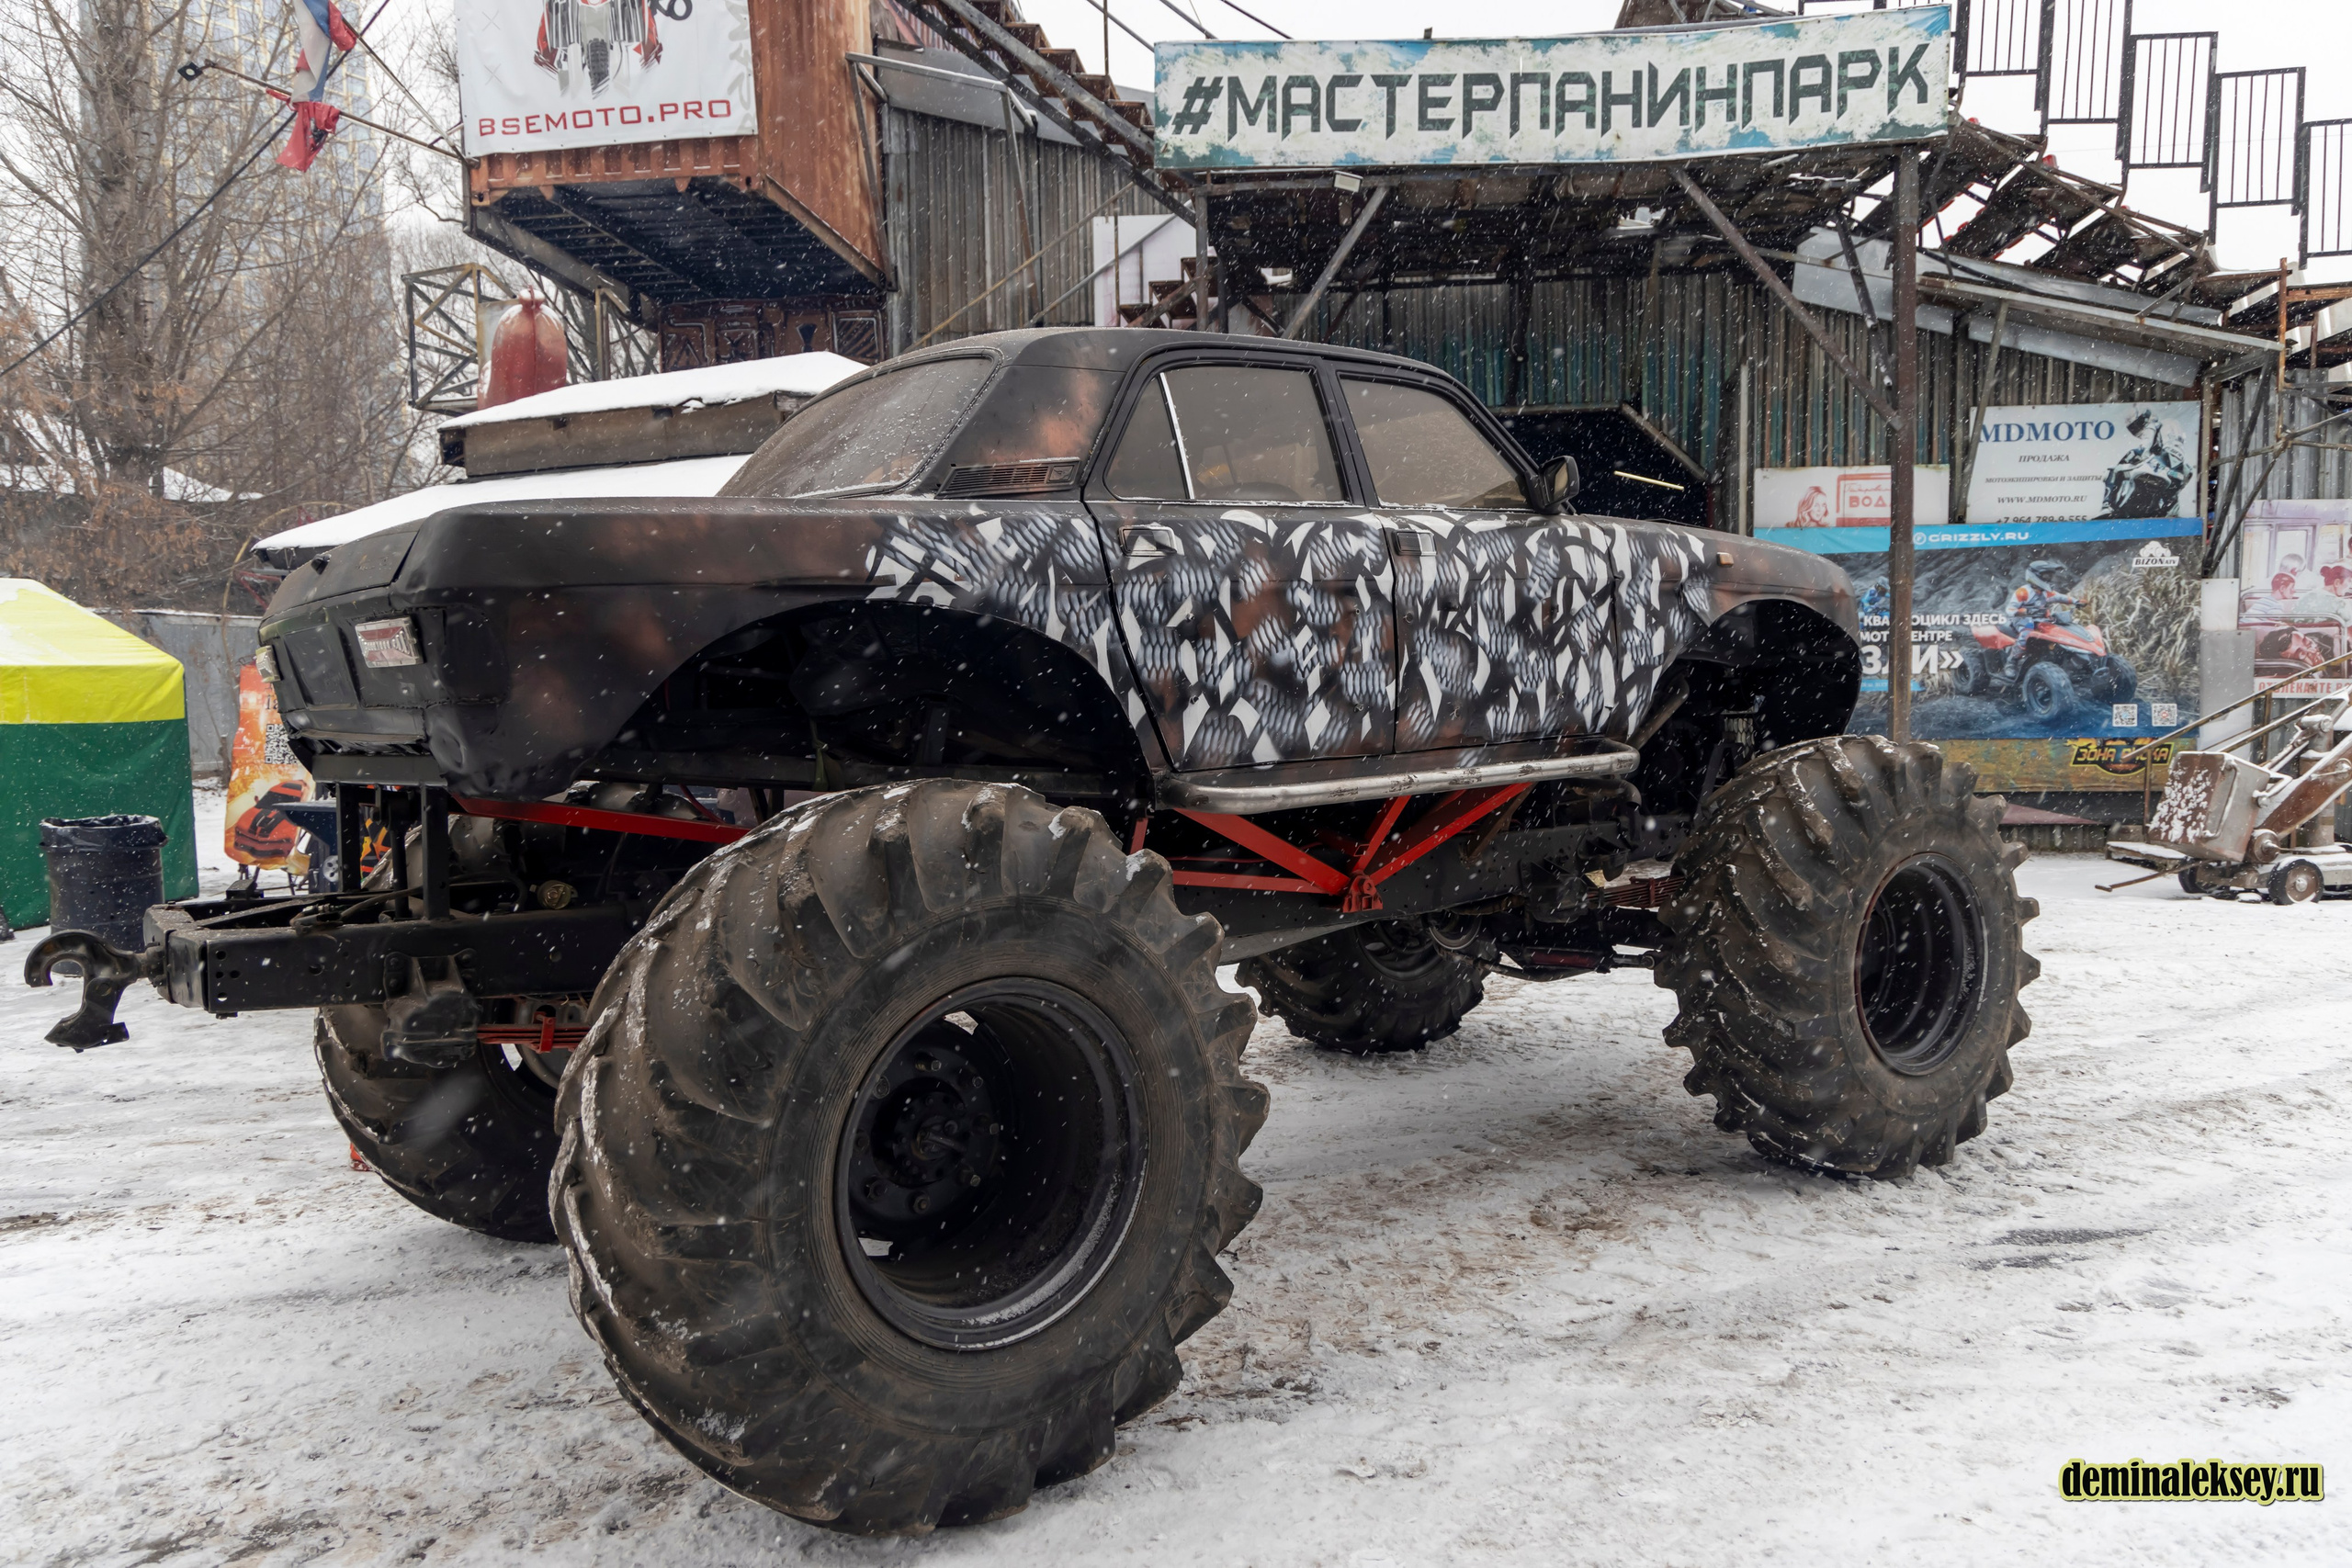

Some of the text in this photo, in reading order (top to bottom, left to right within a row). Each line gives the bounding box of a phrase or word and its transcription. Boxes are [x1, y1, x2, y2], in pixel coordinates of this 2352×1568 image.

[1171, 43, 1930, 143] #МАСТЕРПАНИНПАРК
[479, 98, 731, 137] BSEMOTO.PRO
[1979, 420, 2116, 444] MDMOTO
[2018, 455, 2071, 463] ПРОДАЖА
[1849, 495, 1891, 508] ВОД
[1996, 495, 2088, 504] WWW.MDMOTO.RU
[1928, 531, 2030, 542] GRIZZLY.RU
[1962, 614, 2007, 626] ЗДЕСЬ
[2077, 747, 2116, 761] ЗОНА
